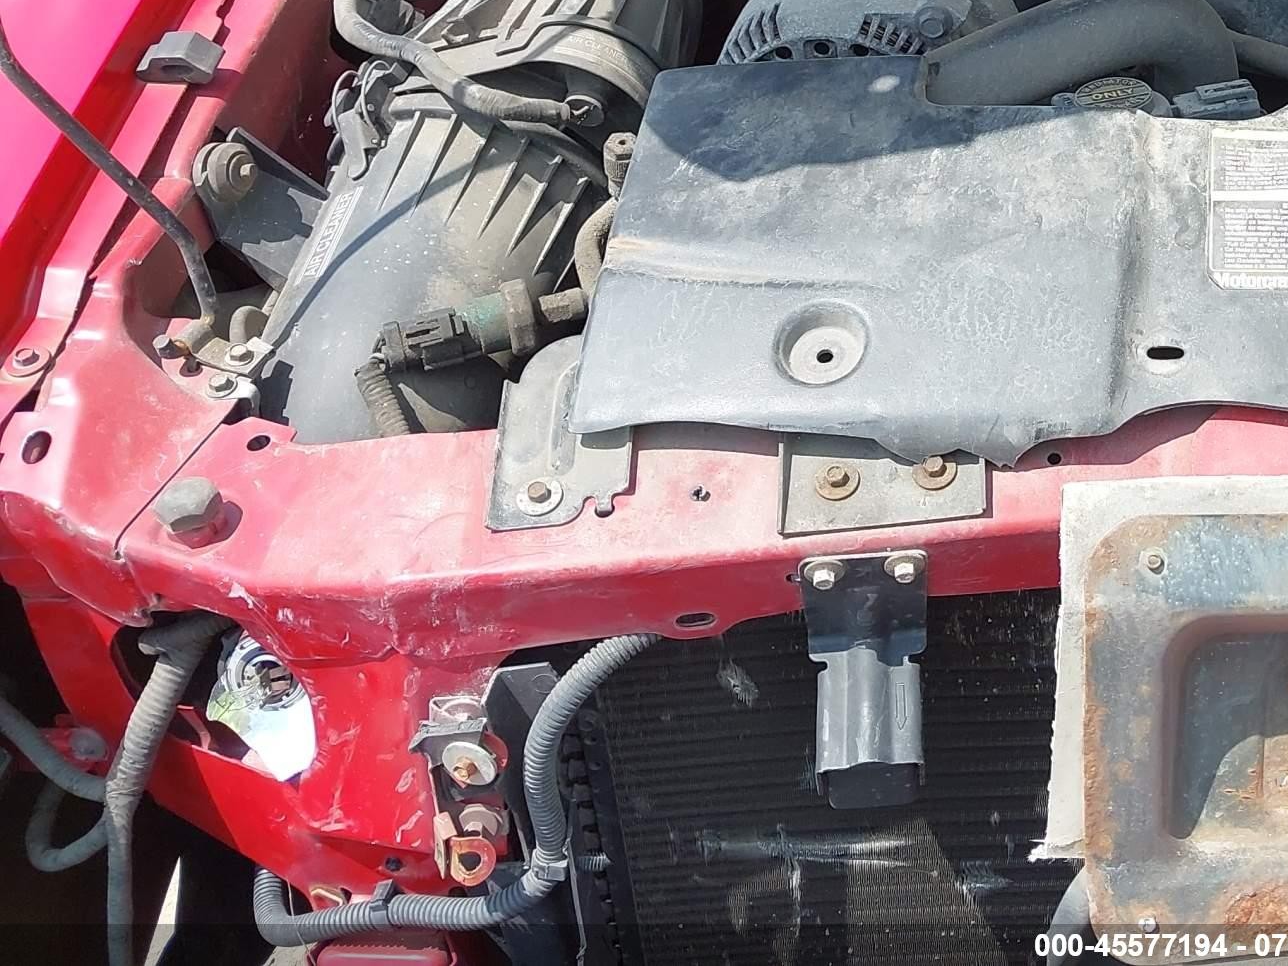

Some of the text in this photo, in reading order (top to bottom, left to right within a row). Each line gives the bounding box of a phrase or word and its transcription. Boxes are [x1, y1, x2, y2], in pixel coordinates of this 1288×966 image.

[584, 37, 630, 65] CLEANER
[1092, 88, 1133, 101] ONLY
[304, 192, 353, 276] AIR CLEANER
